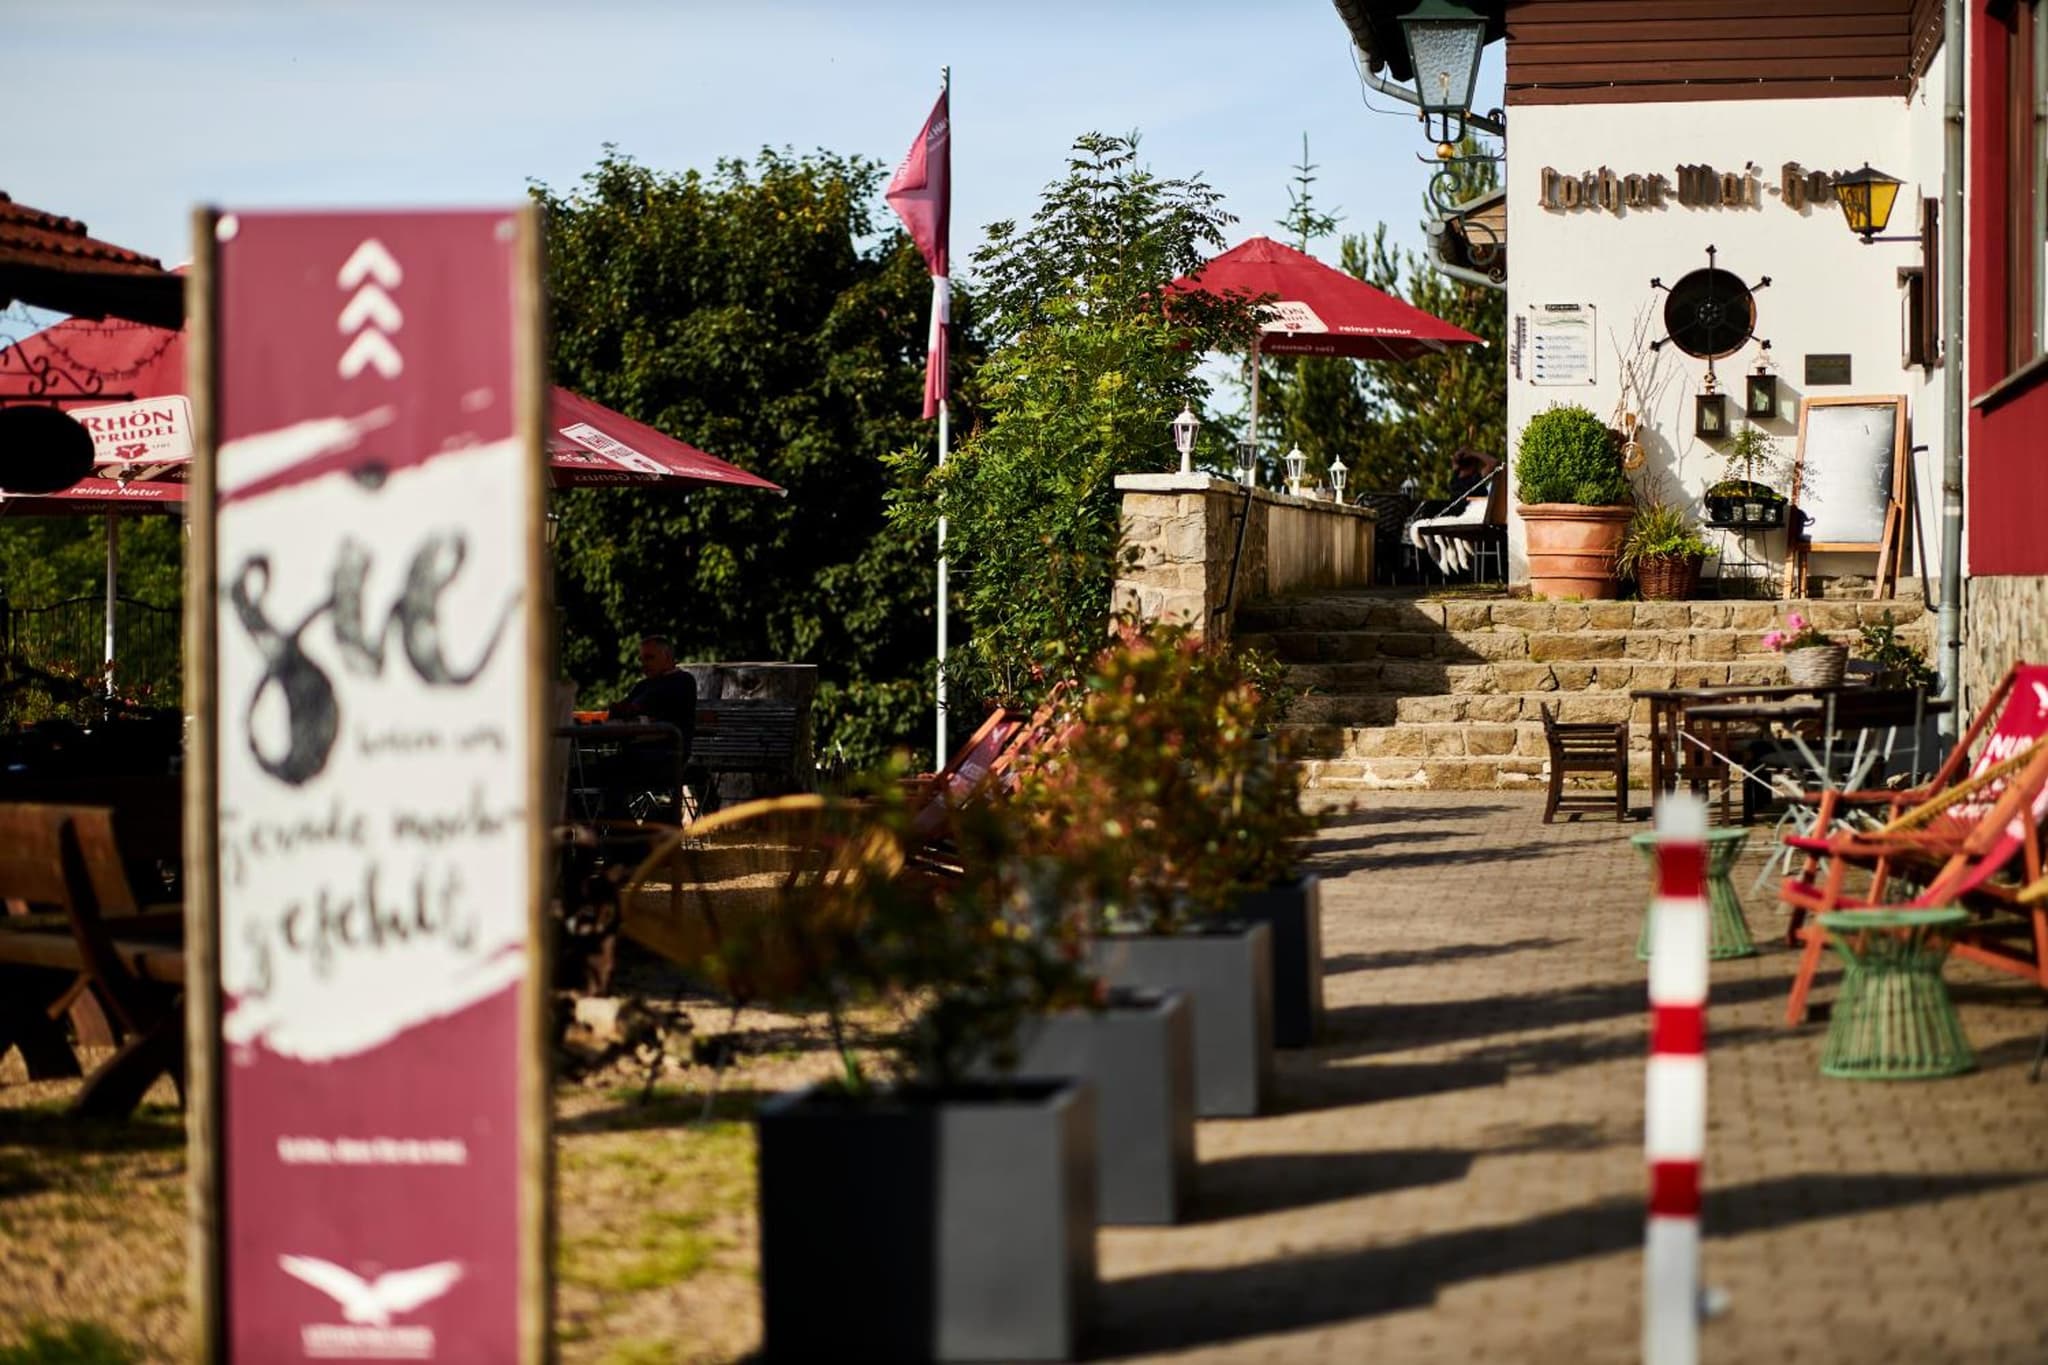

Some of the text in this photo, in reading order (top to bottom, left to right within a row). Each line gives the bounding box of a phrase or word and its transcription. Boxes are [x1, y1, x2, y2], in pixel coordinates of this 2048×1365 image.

[1375, 327, 1412, 335] Natur
[81, 409, 174, 432] RHÖN
[94, 425, 177, 444] PRUDEL
[70, 486, 163, 497] reiner Natur
